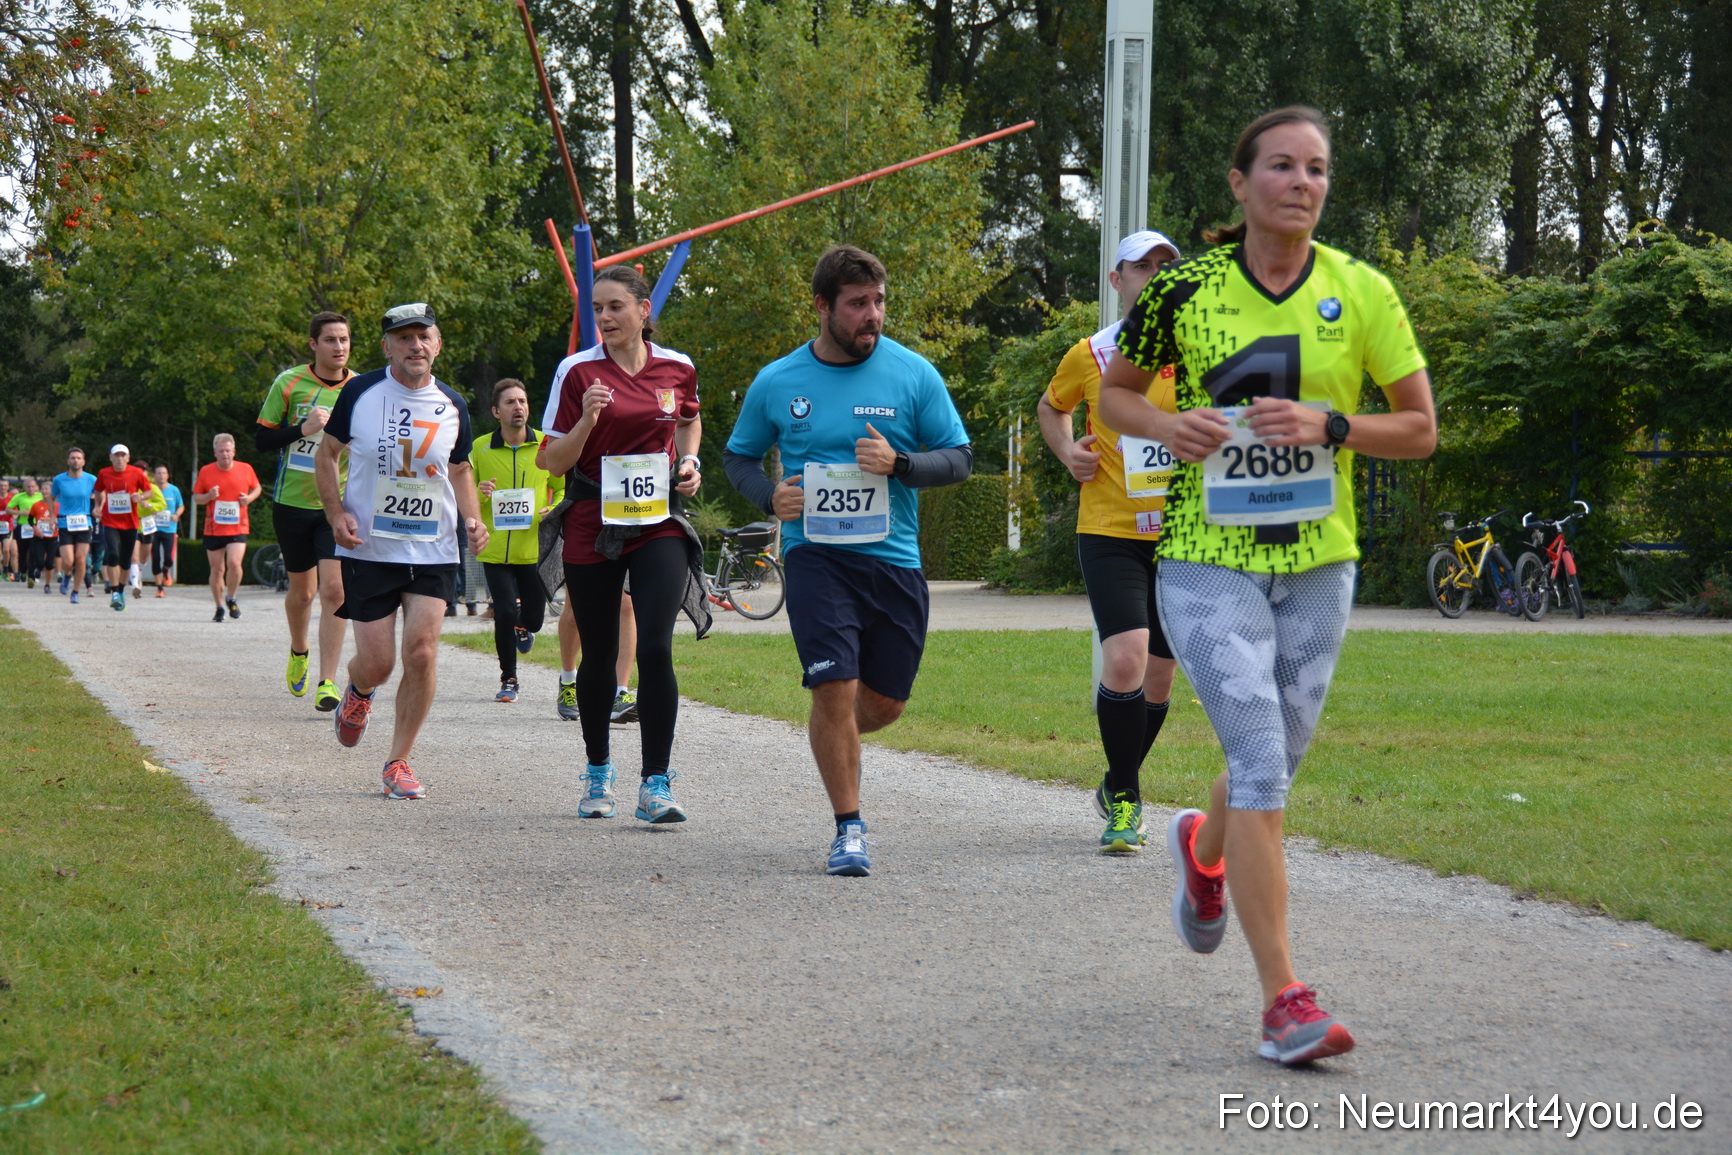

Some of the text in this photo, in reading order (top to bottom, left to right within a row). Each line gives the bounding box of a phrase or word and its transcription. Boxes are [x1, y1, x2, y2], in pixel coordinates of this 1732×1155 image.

[853, 406, 896, 417] BOCK
[387, 418, 396, 448] LAUF
[1142, 444, 1177, 468] 26
[1222, 443, 1314, 480] 2686
[620, 476, 655, 498] 165
[816, 487, 876, 512] 2357
[1247, 491, 1294, 505] Andrea
[217, 507, 236, 516] 2540
[383, 495, 433, 517] 2420
[498, 501, 530, 514] 2375
[623, 505, 653, 513] Rebecca
[391, 521, 422, 531] Klemens
[838, 521, 854, 530] Roi
